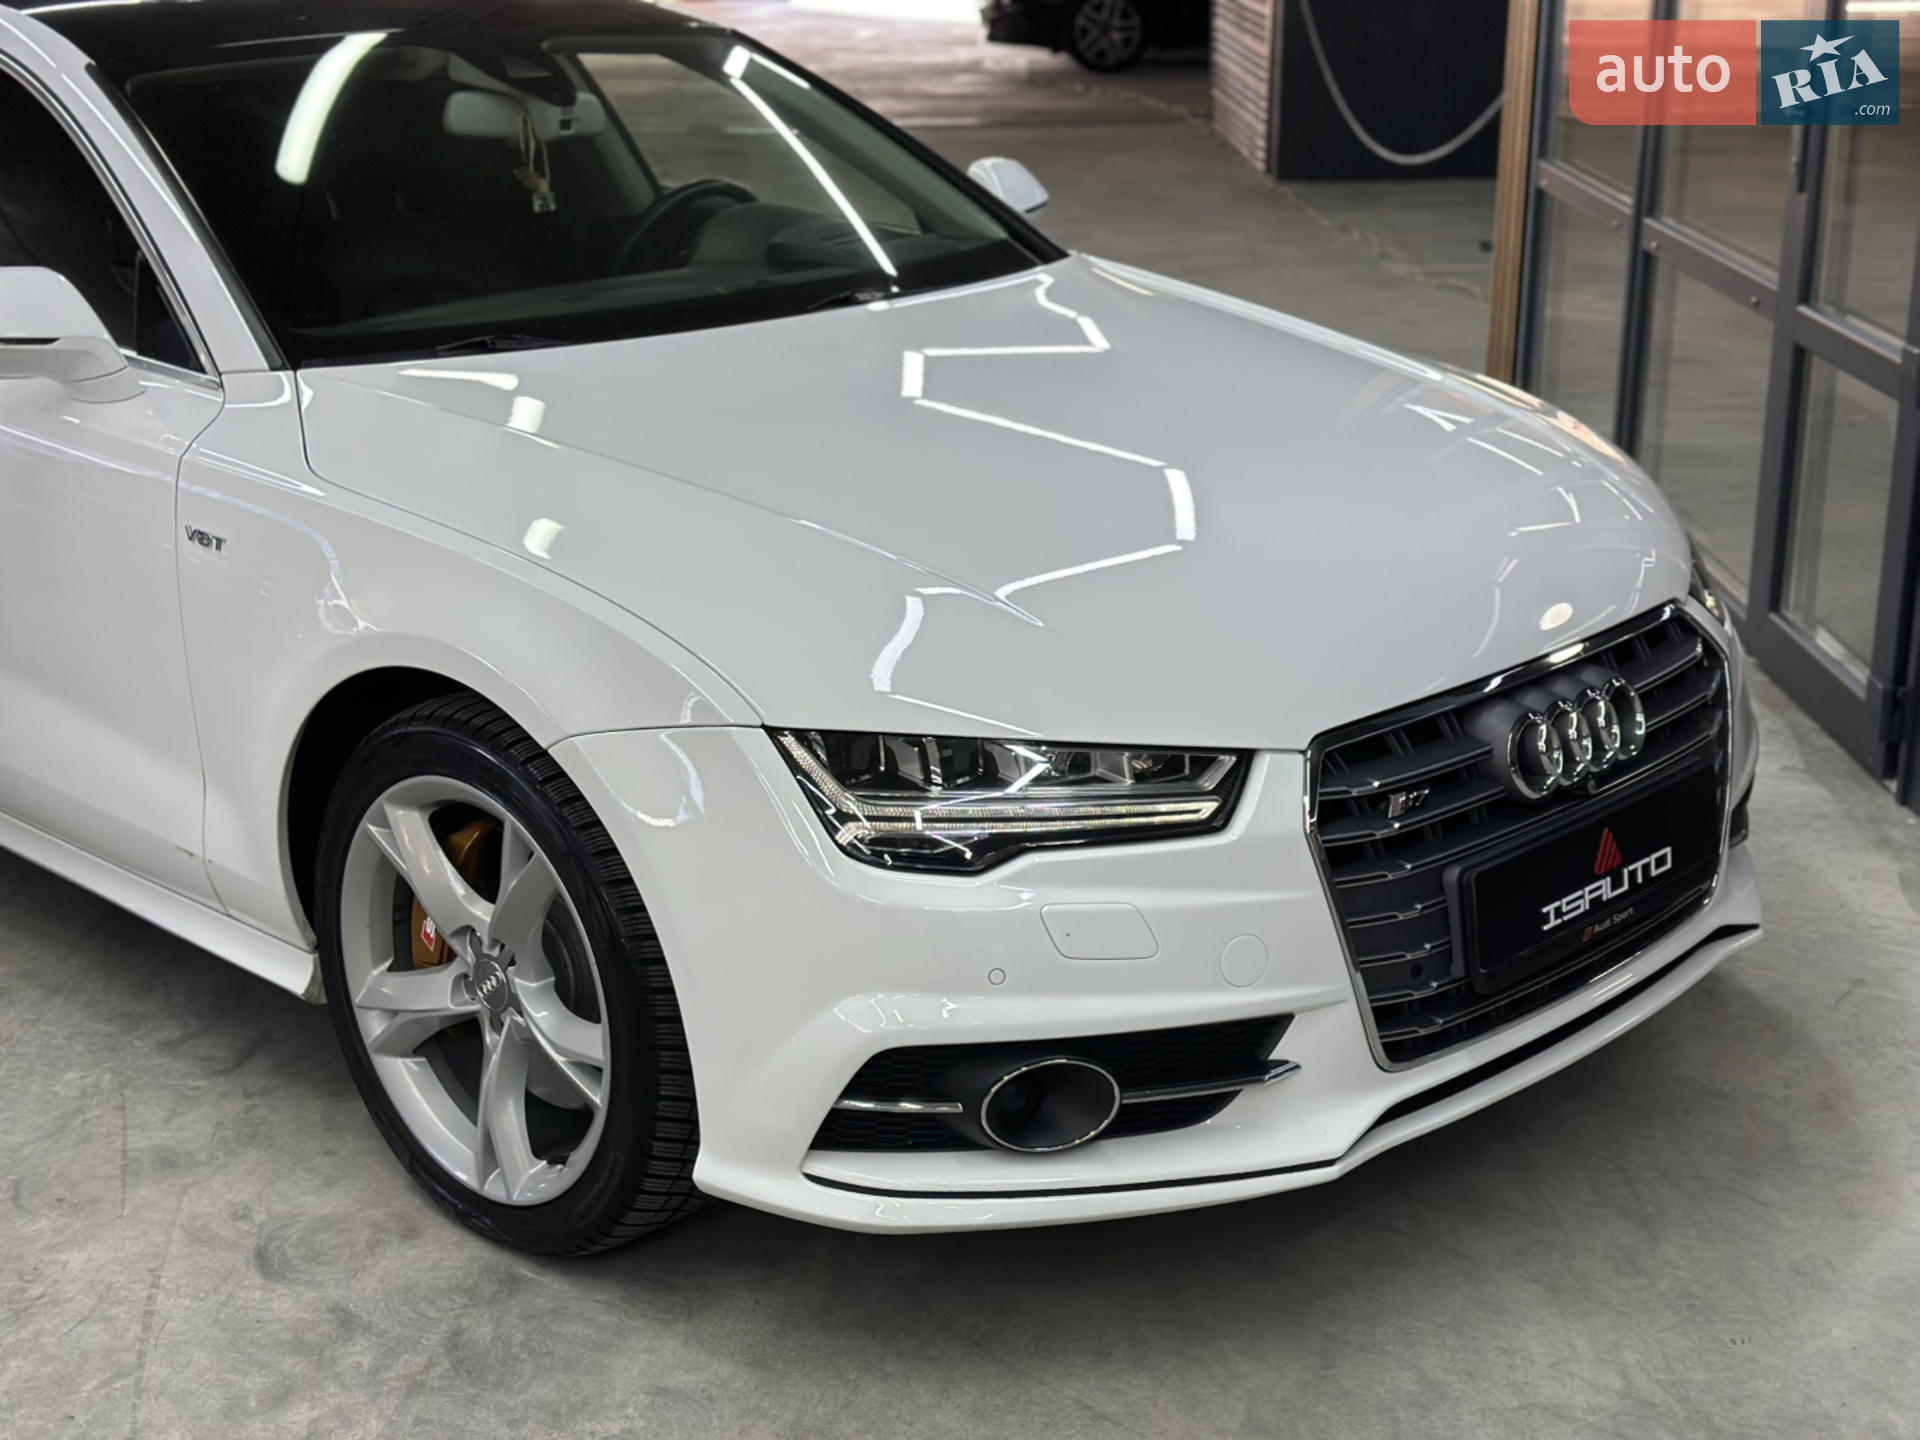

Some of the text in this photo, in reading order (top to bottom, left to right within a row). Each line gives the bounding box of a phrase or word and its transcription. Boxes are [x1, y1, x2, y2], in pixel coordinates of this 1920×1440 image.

[1541, 846, 1672, 931] ISAUTO
[1593, 906, 1635, 934] Audi Sport
